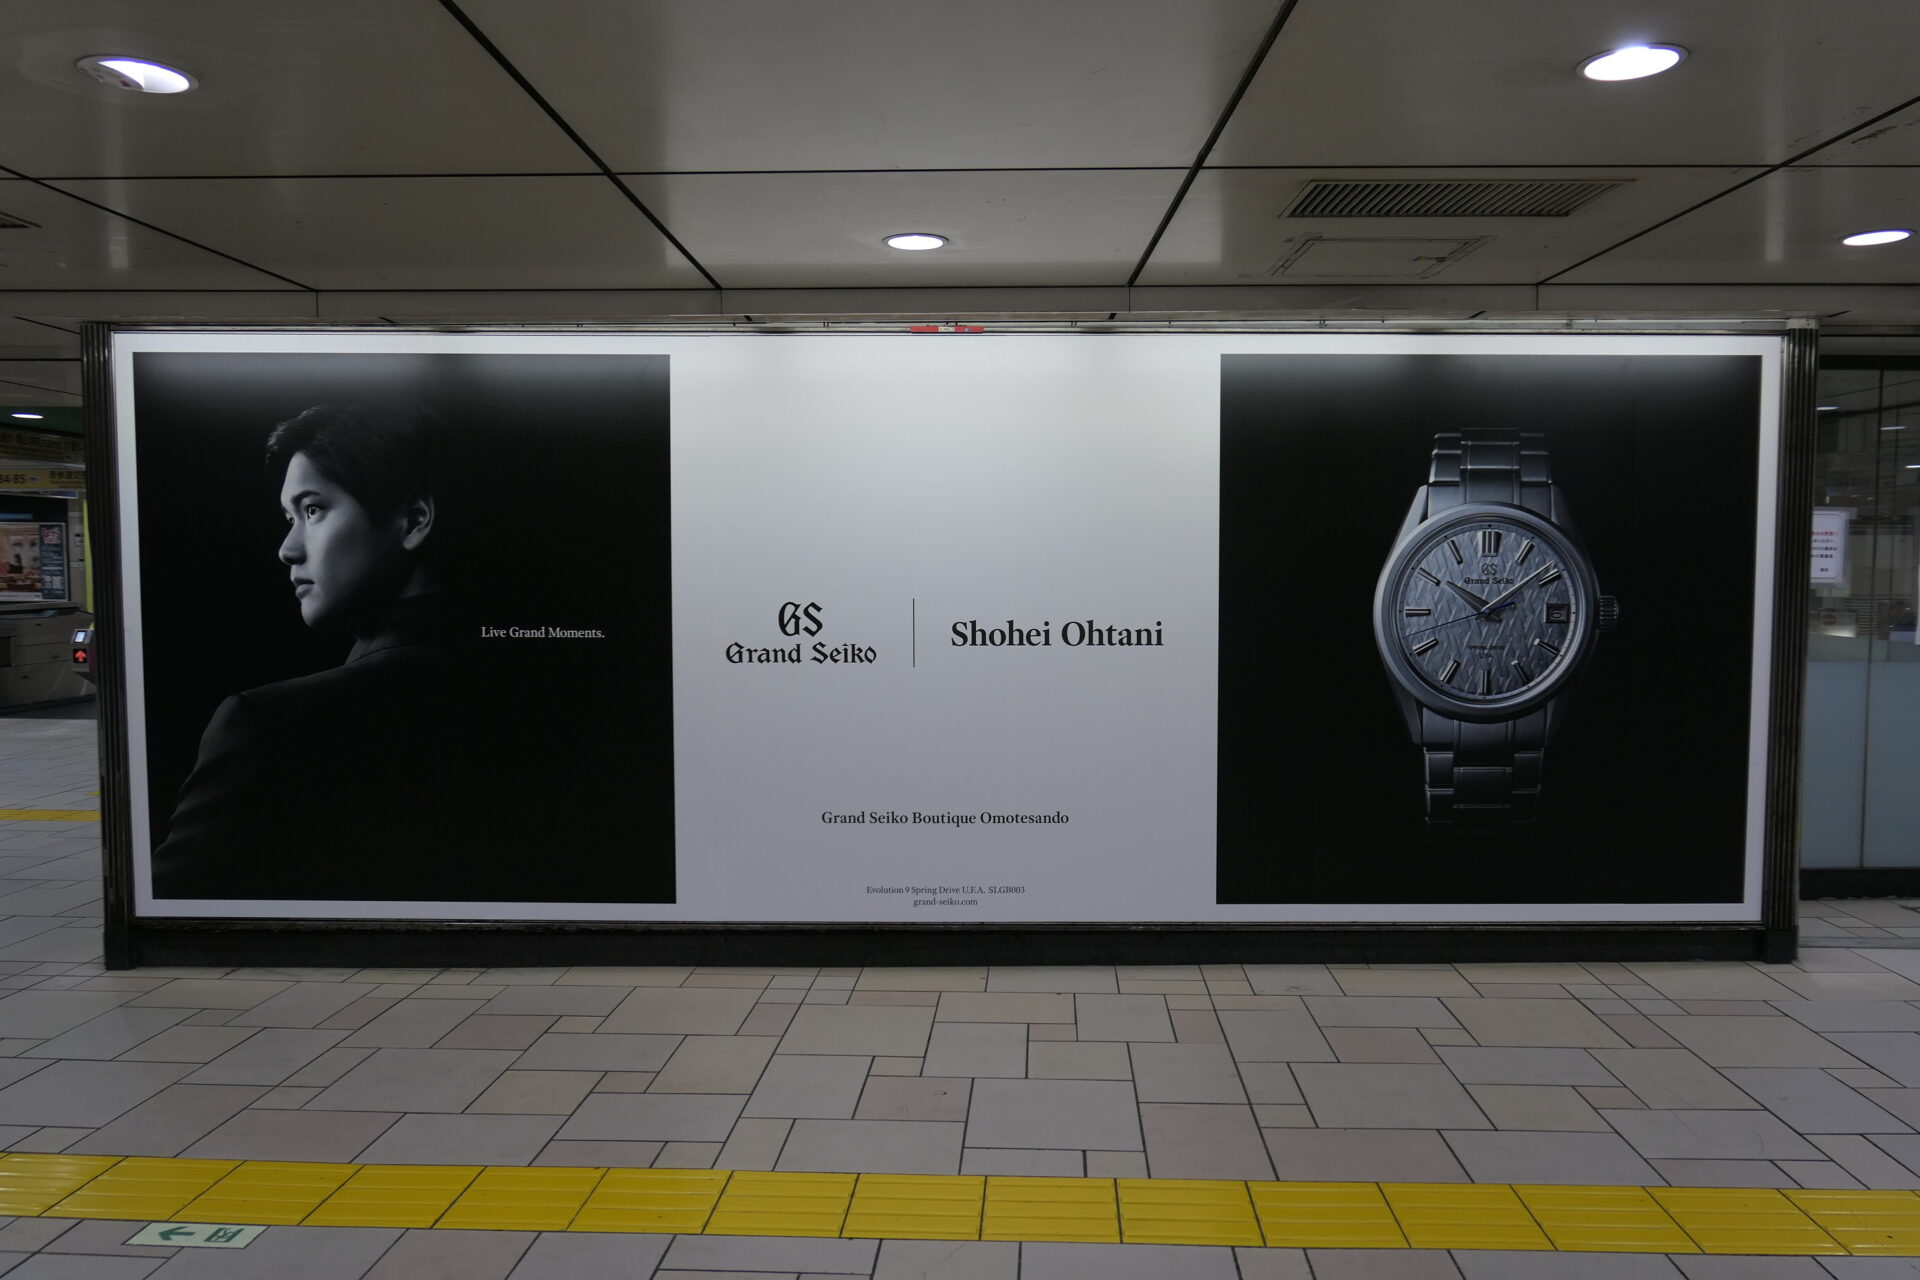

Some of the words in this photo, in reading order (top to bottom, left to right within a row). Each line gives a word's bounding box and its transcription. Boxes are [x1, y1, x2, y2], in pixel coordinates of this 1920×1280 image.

[777, 601, 824, 638] GS
[481, 626, 507, 638] Live
[509, 626, 546, 638] Grand
[548, 626, 606, 639] Moments.
[951, 619, 1052, 647] Shohei
[1061, 619, 1165, 647] Ohtani
[725, 641, 802, 665] Grand
[810, 641, 877, 665] Seiko
[821, 810, 866, 824] Grand
[869, 810, 909, 824] Seiko
[912, 810, 977, 828] Boutique
[979, 810, 1070, 825] Omotesando
[866, 885, 904, 894] Evolution
[904, 886, 910, 894] 9
[911, 886, 938, 896] Spring
[938, 885, 960, 894] Drive
[962, 886, 986, 894] U.F.A.
[913, 897, 978, 908] grand-seiko.com
